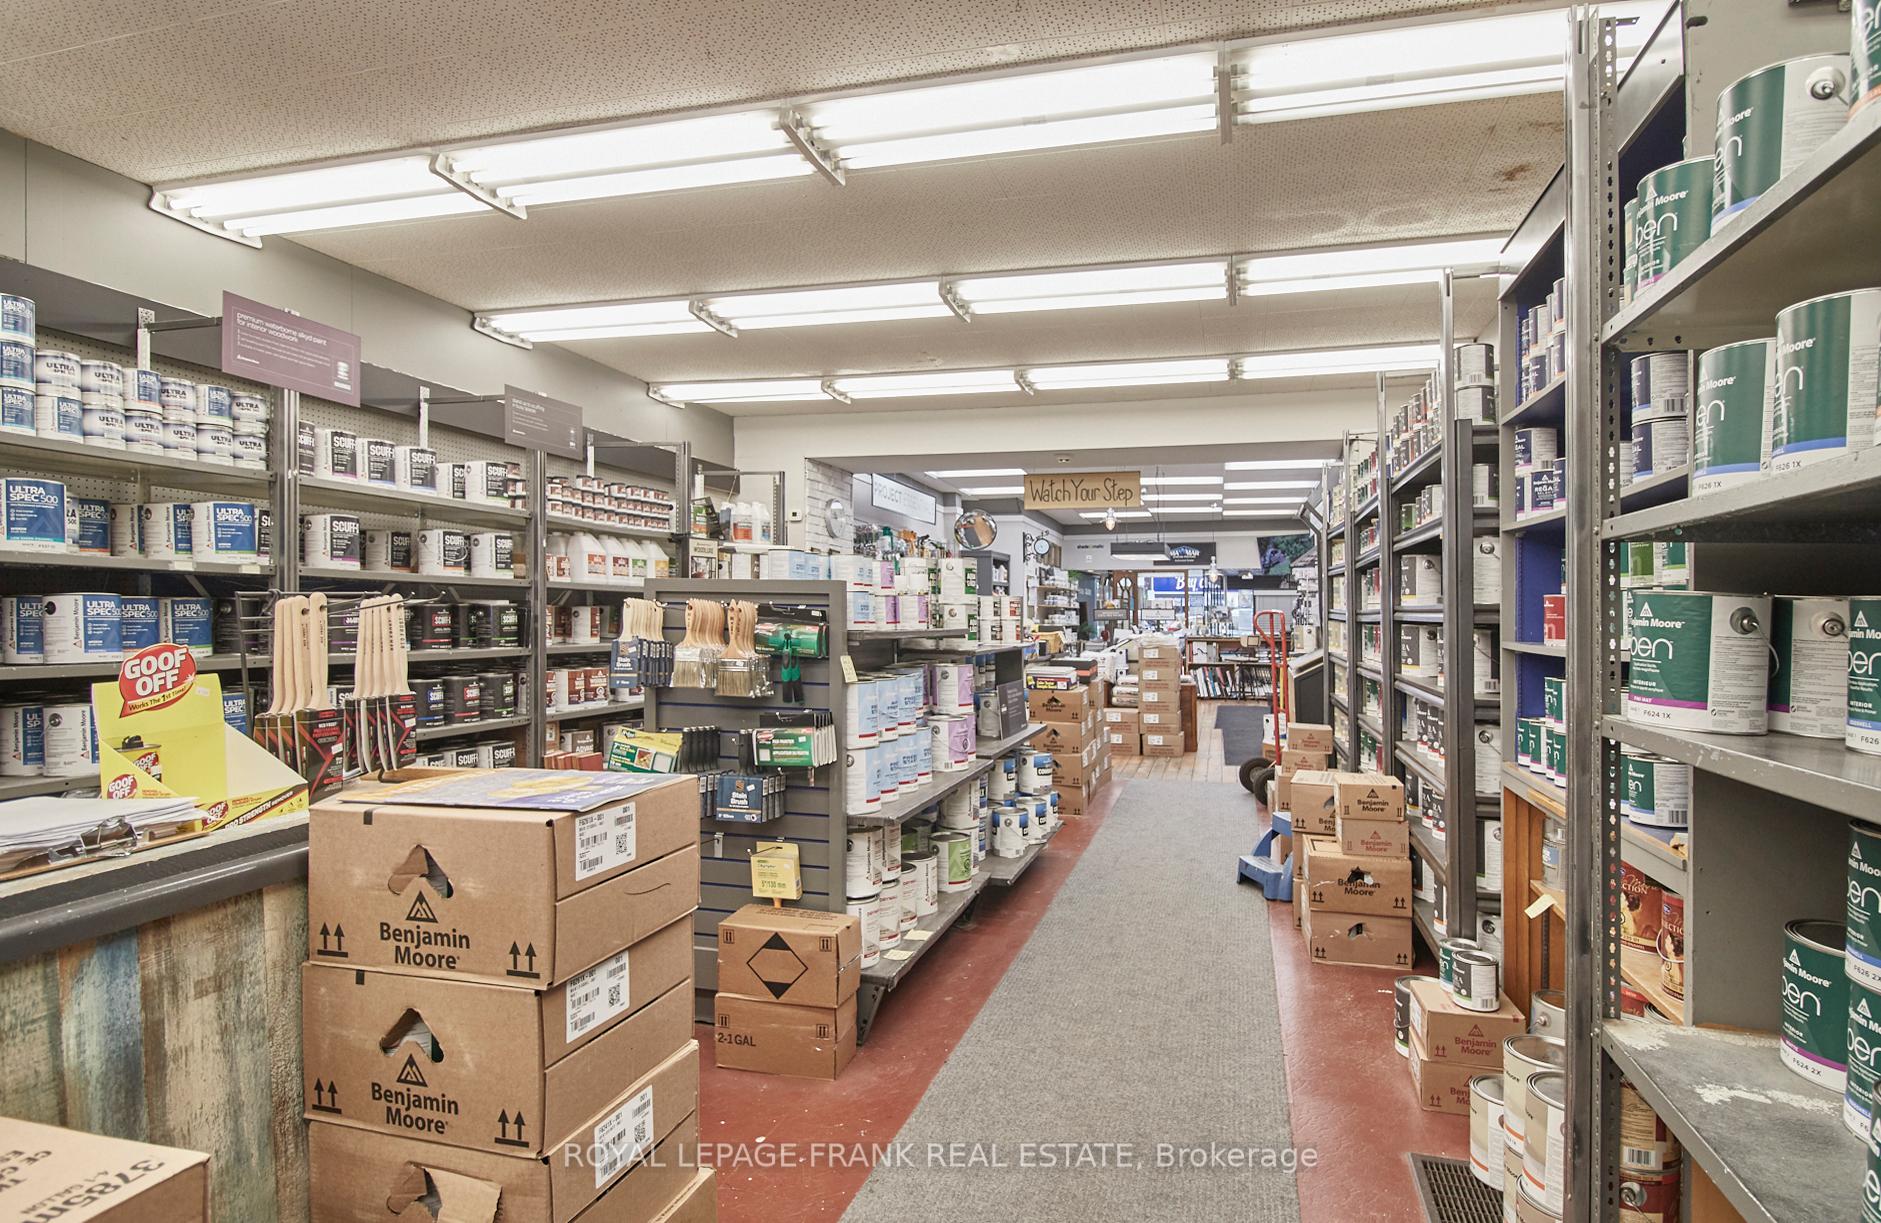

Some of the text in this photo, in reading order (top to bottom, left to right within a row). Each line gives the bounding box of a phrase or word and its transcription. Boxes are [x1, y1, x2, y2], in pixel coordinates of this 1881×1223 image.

[1655, 191, 1687, 206] Moore
[46, 362, 75, 372] ULTRA
[161, 388, 187, 396] ULTRA
[235, 401, 259, 409] ULTRA
[134, 422, 160, 431] ULTRA
[239, 440, 262, 448] ULTRA
[10, 485, 45, 495] ULTRA
[1029, 477, 1133, 506] Watch Your Step
[10, 493, 58, 504] SPEC 500
[79, 504, 105, 513] ULTRA
[216, 507, 244, 515] ULTRA
[79, 511, 101, 519] SPEC
[216, 514, 239, 522] SPEC
[86, 600, 115, 608] ULTRA
[122, 604, 150, 612] ULTRA
[87, 608, 111, 616] SPEC
[1650, 618, 1682, 628] Moore
[124, 648, 188, 679] GOOF
[136, 669, 178, 696] OFF
[129, 701, 149, 711] Works
[150, 699, 160, 707] The
[162, 694, 172, 702] 1st
[1860, 736, 1880, 745] F626
[109, 775, 134, 792] GOOF
[731, 791, 747, 799] Stain
[239, 801, 271, 825] STRENGTH
[1344, 888, 1375, 896] Moore
[379, 922, 471, 949] Benjamin
[394, 945, 457, 969] Moore
[1798, 968, 1830, 987] Moore
[1454, 1037, 1497, 1048] Benjamin
[1461, 1047, 1490, 1056] Moore
[371, 1082, 459, 1115] Benjamin
[386, 1105, 446, 1134] Moore
